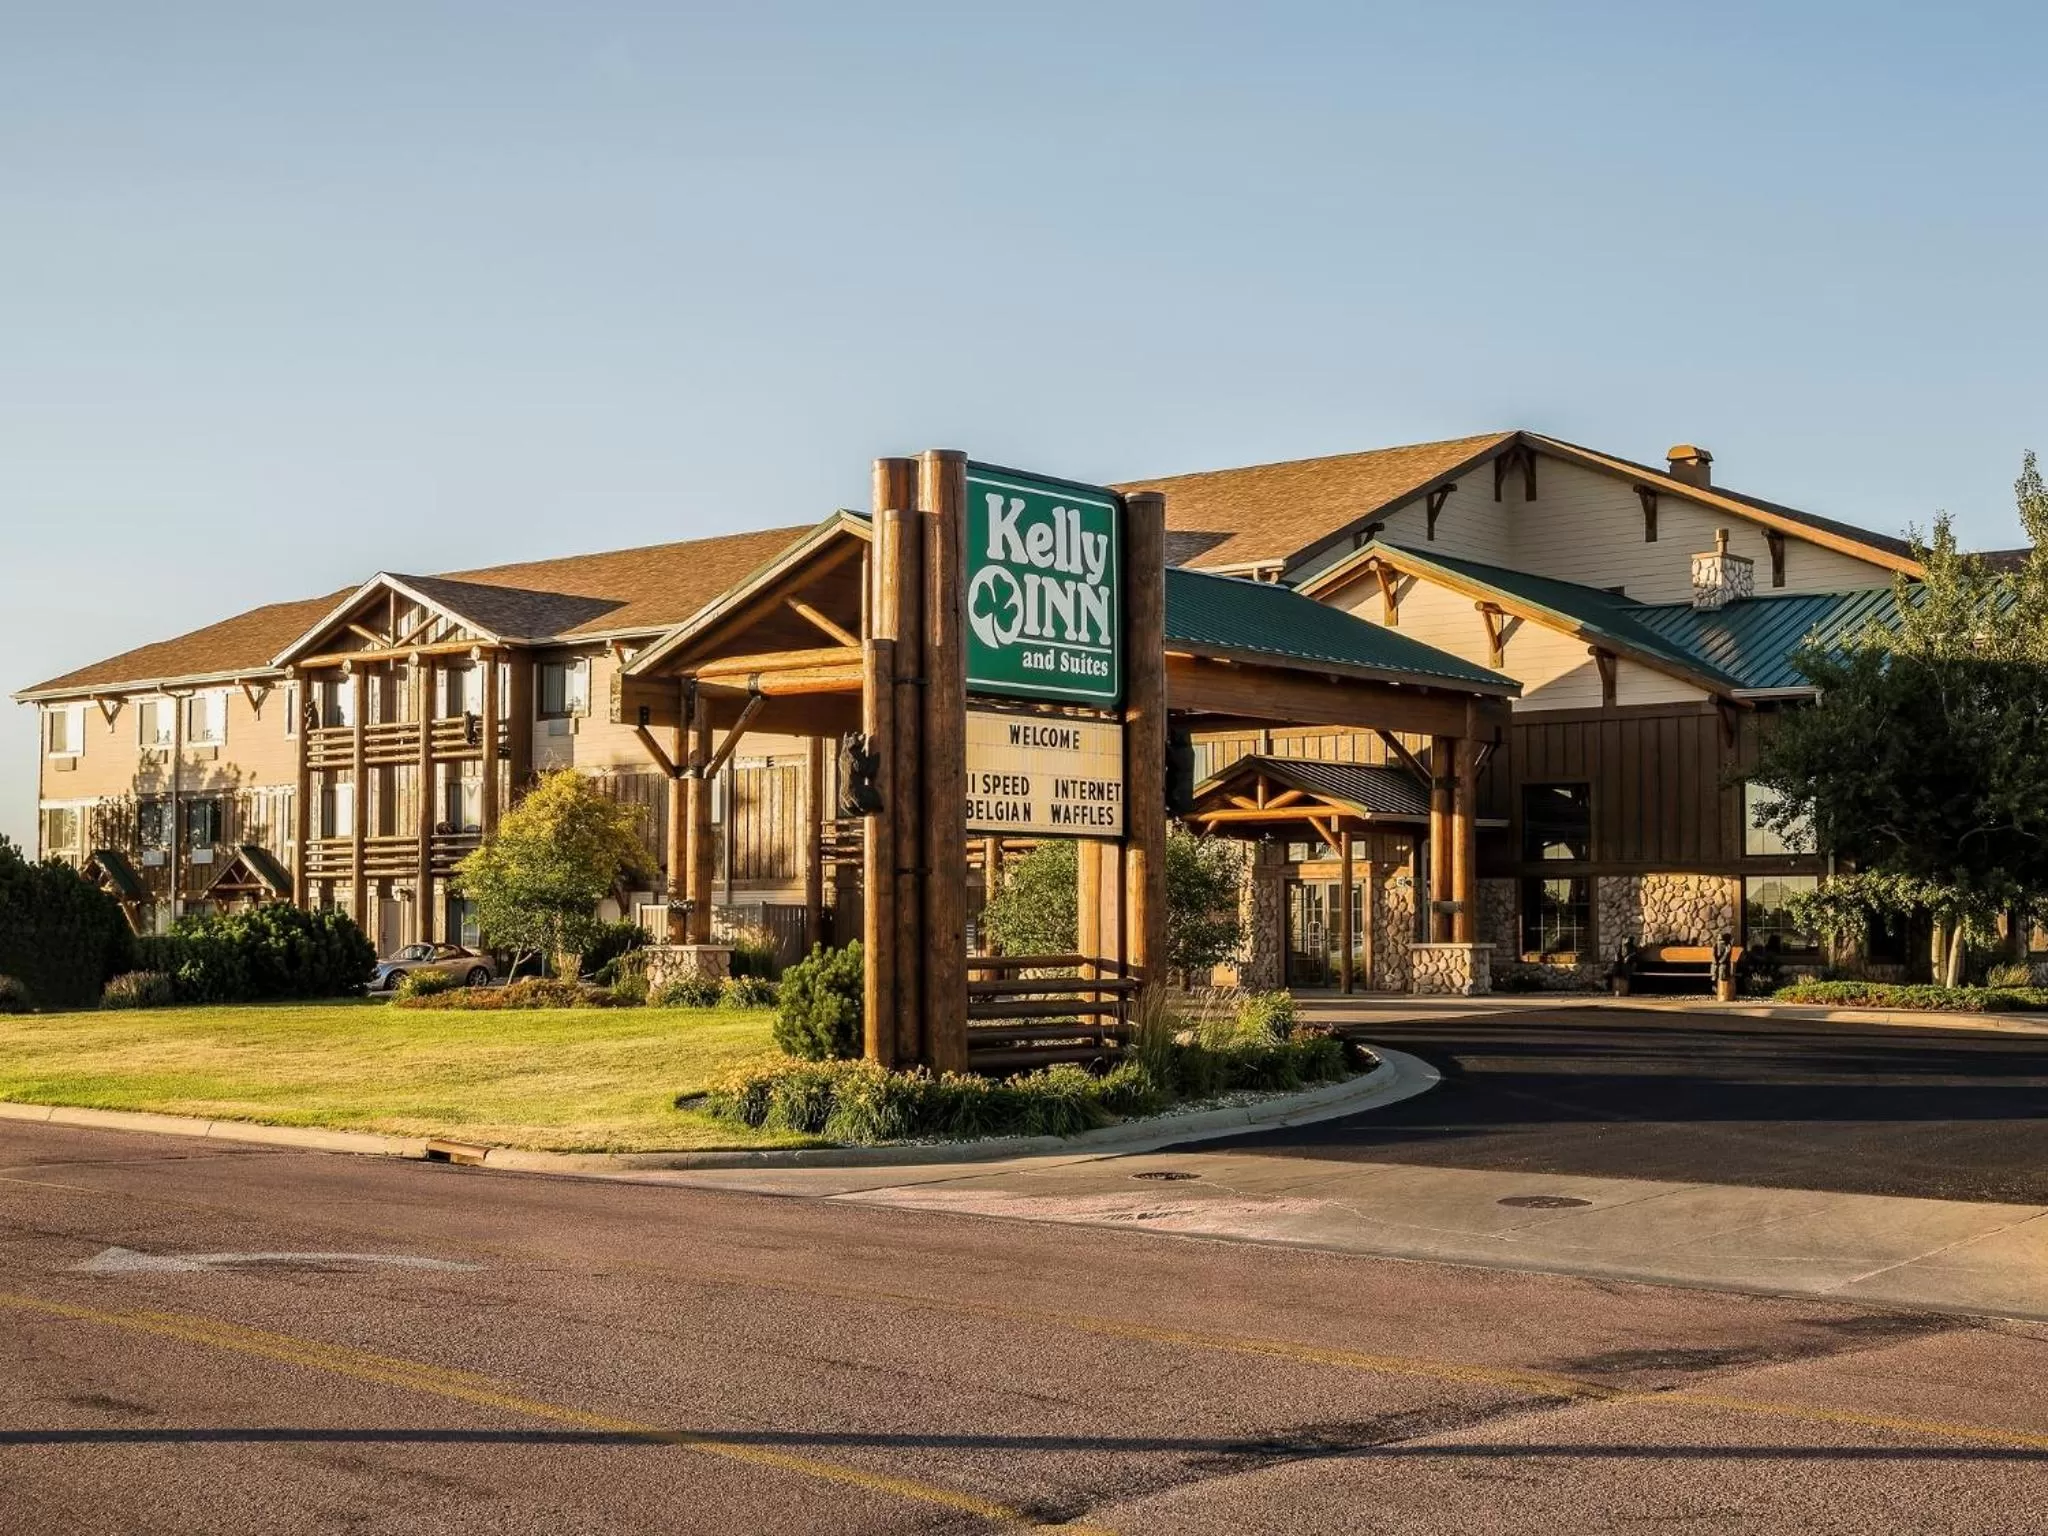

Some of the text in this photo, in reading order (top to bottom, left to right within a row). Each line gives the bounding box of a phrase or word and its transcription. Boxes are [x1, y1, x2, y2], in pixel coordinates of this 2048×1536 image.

[985, 493, 1108, 585] Kelly
[1023, 573, 1111, 645] INN
[1022, 650, 1109, 676] and Suites
[1009, 724, 1080, 749] WELCOME
[982, 774, 1030, 796] SPEED
[1054, 779, 1121, 801] INTERNET
[966, 800, 1114, 826] BELGIAN WAFFLES
